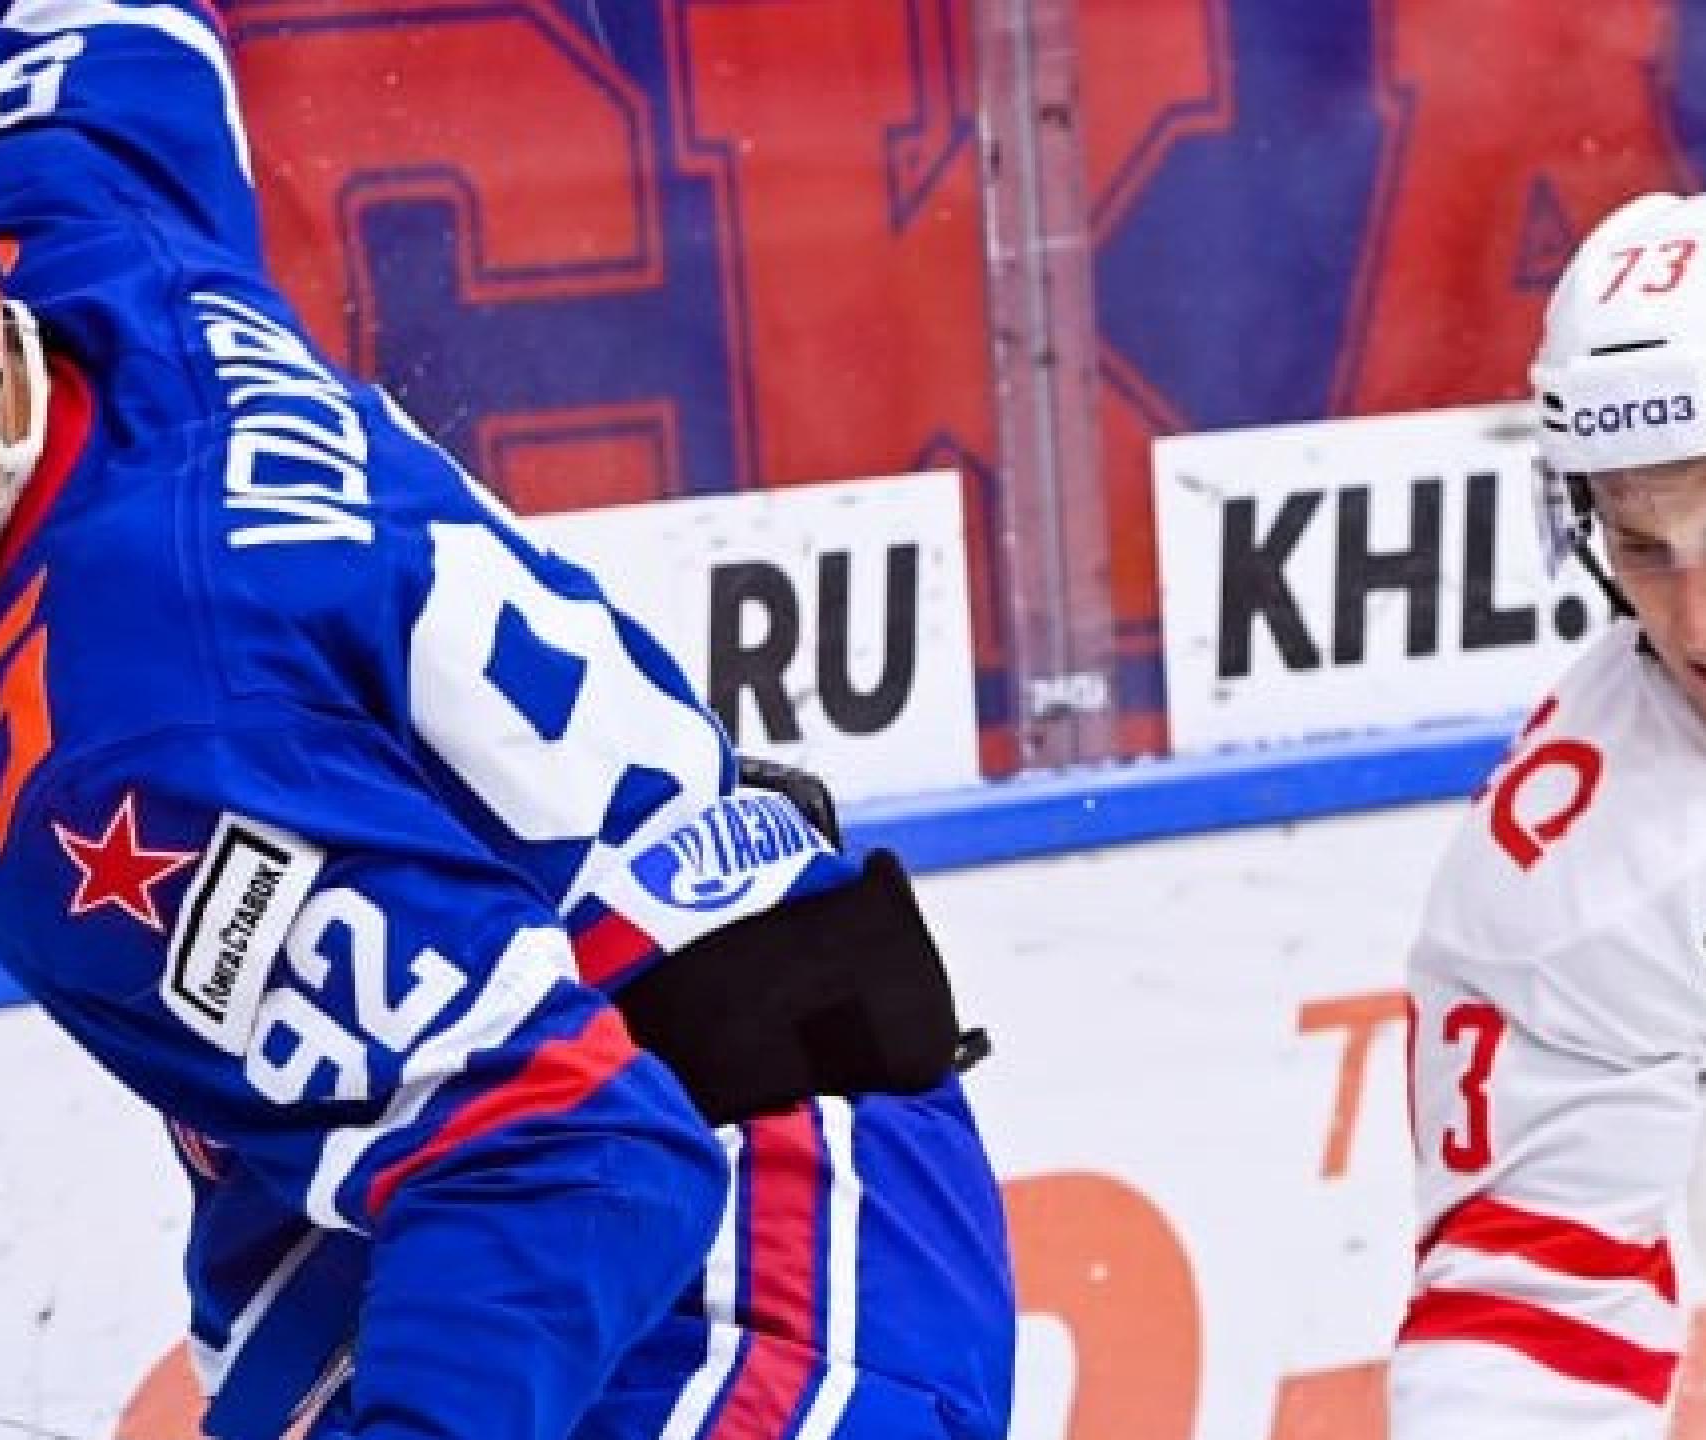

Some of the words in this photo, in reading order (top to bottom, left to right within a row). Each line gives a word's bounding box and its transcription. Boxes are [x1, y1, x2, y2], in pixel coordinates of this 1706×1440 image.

[1597, 238, 1697, 304] 73
[1215, 470, 1592, 684] KHL.
[245, 886, 468, 1106] 92
